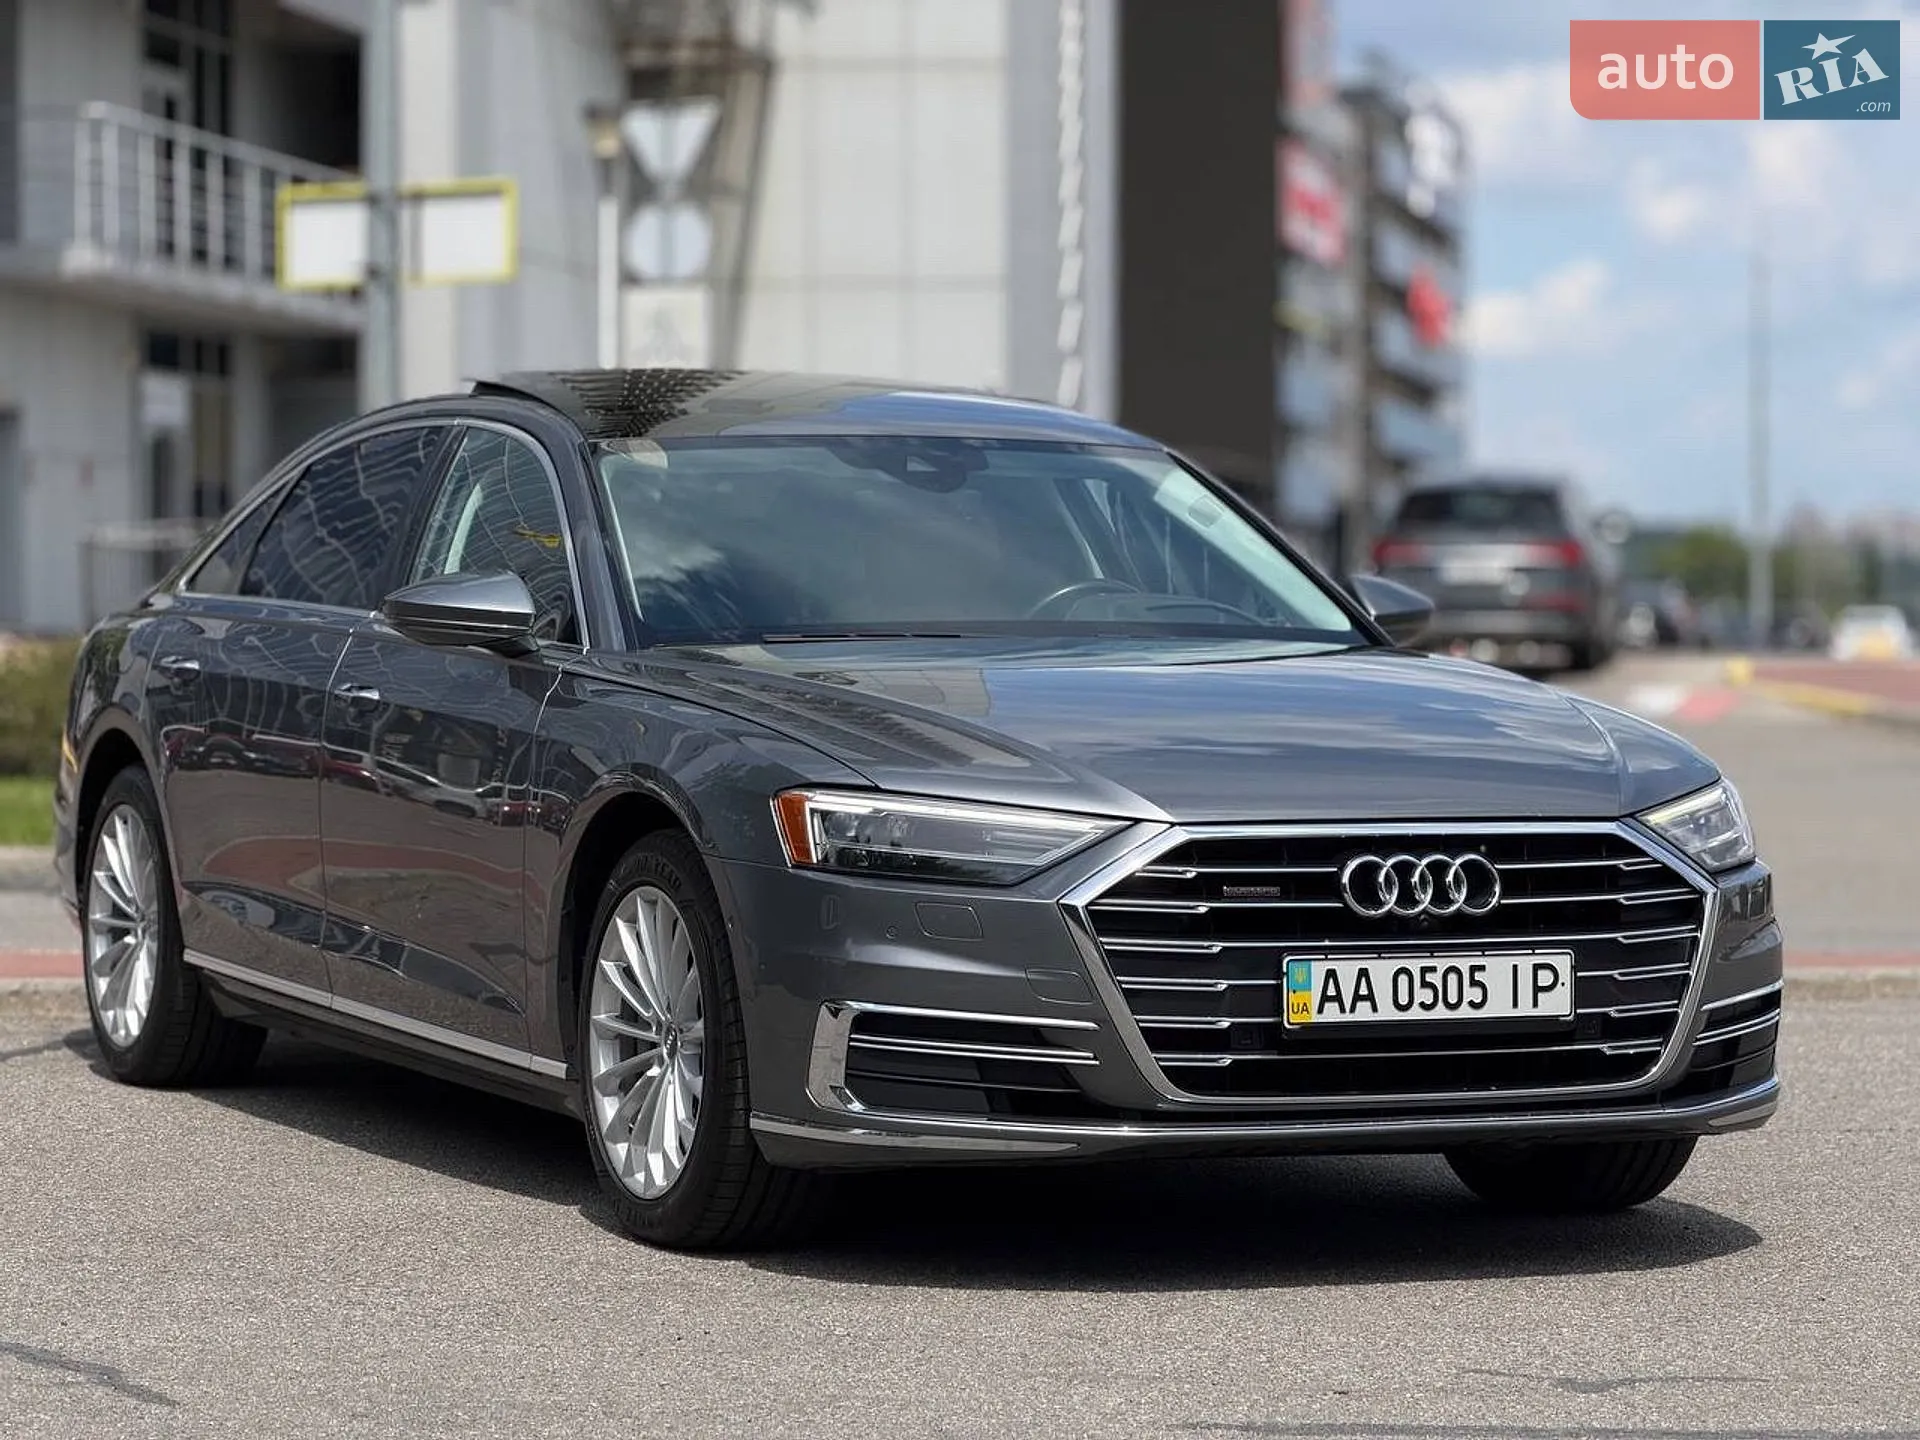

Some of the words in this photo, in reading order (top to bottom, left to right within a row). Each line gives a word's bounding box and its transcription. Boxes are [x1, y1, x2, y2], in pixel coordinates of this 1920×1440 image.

[1317, 967, 1379, 1015] AA
[1391, 964, 1489, 1013] 0505
[1511, 962, 1560, 1010] IP
[1291, 1001, 1310, 1016] UA
